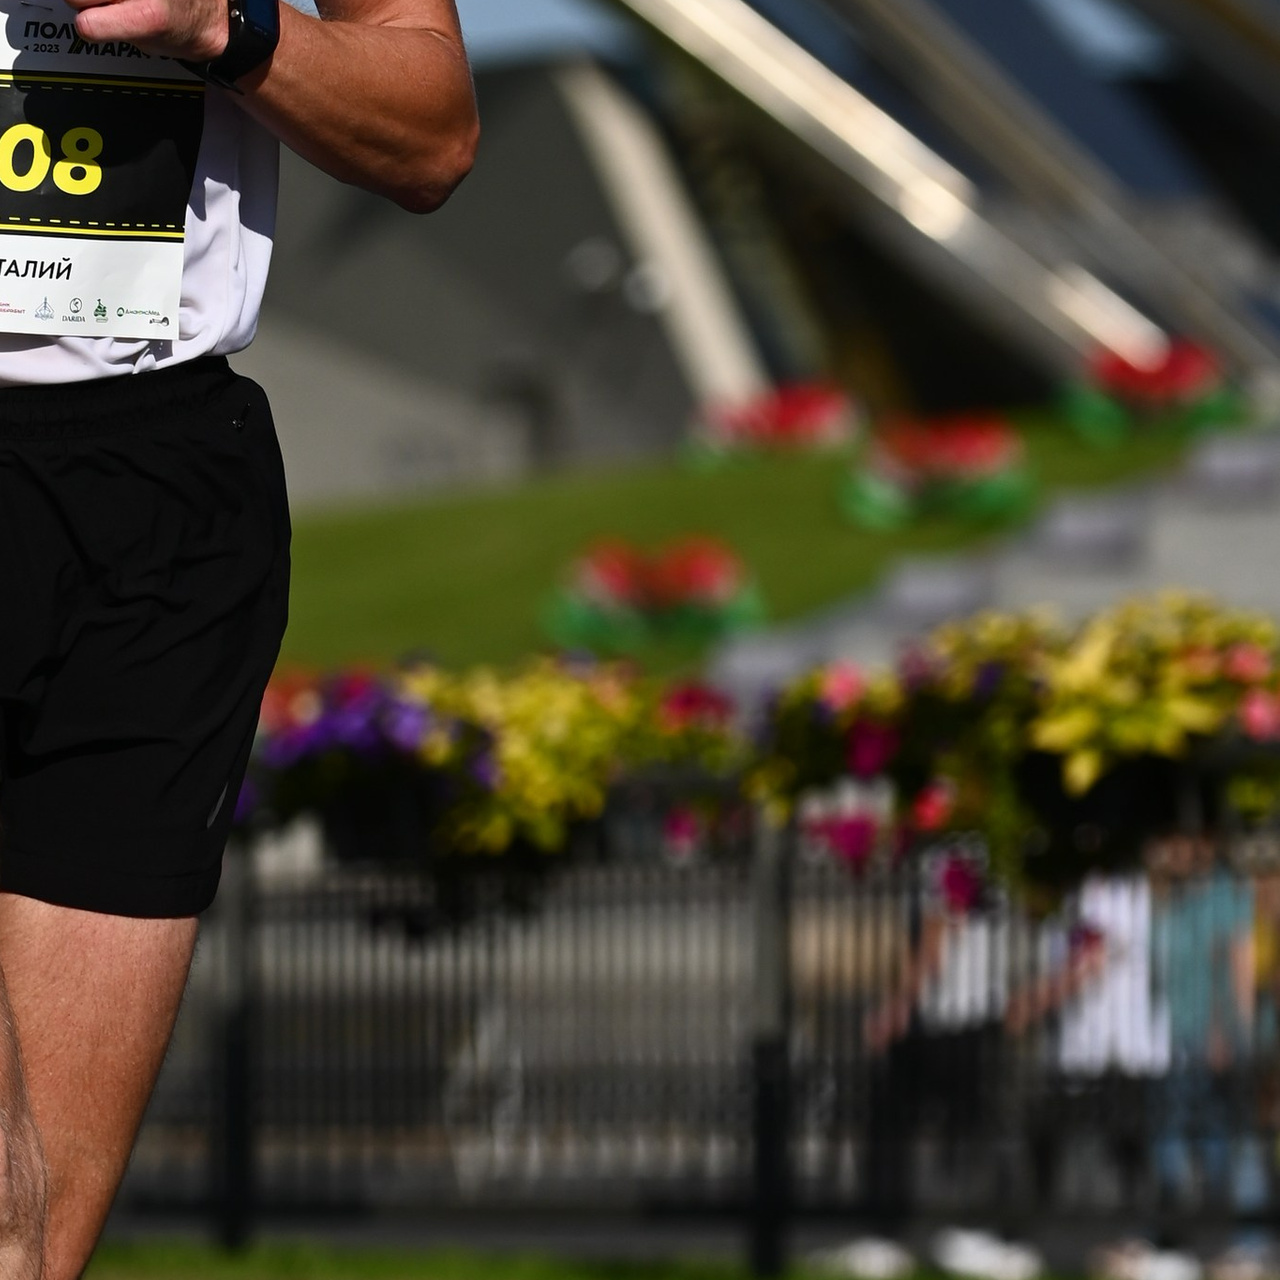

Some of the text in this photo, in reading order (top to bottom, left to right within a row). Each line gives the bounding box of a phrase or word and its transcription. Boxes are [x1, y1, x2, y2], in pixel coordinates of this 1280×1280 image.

[33, 43, 60, 53] 2023
[73, 39, 169, 59] МАРА
[62, 315, 86, 323] DARIDA
